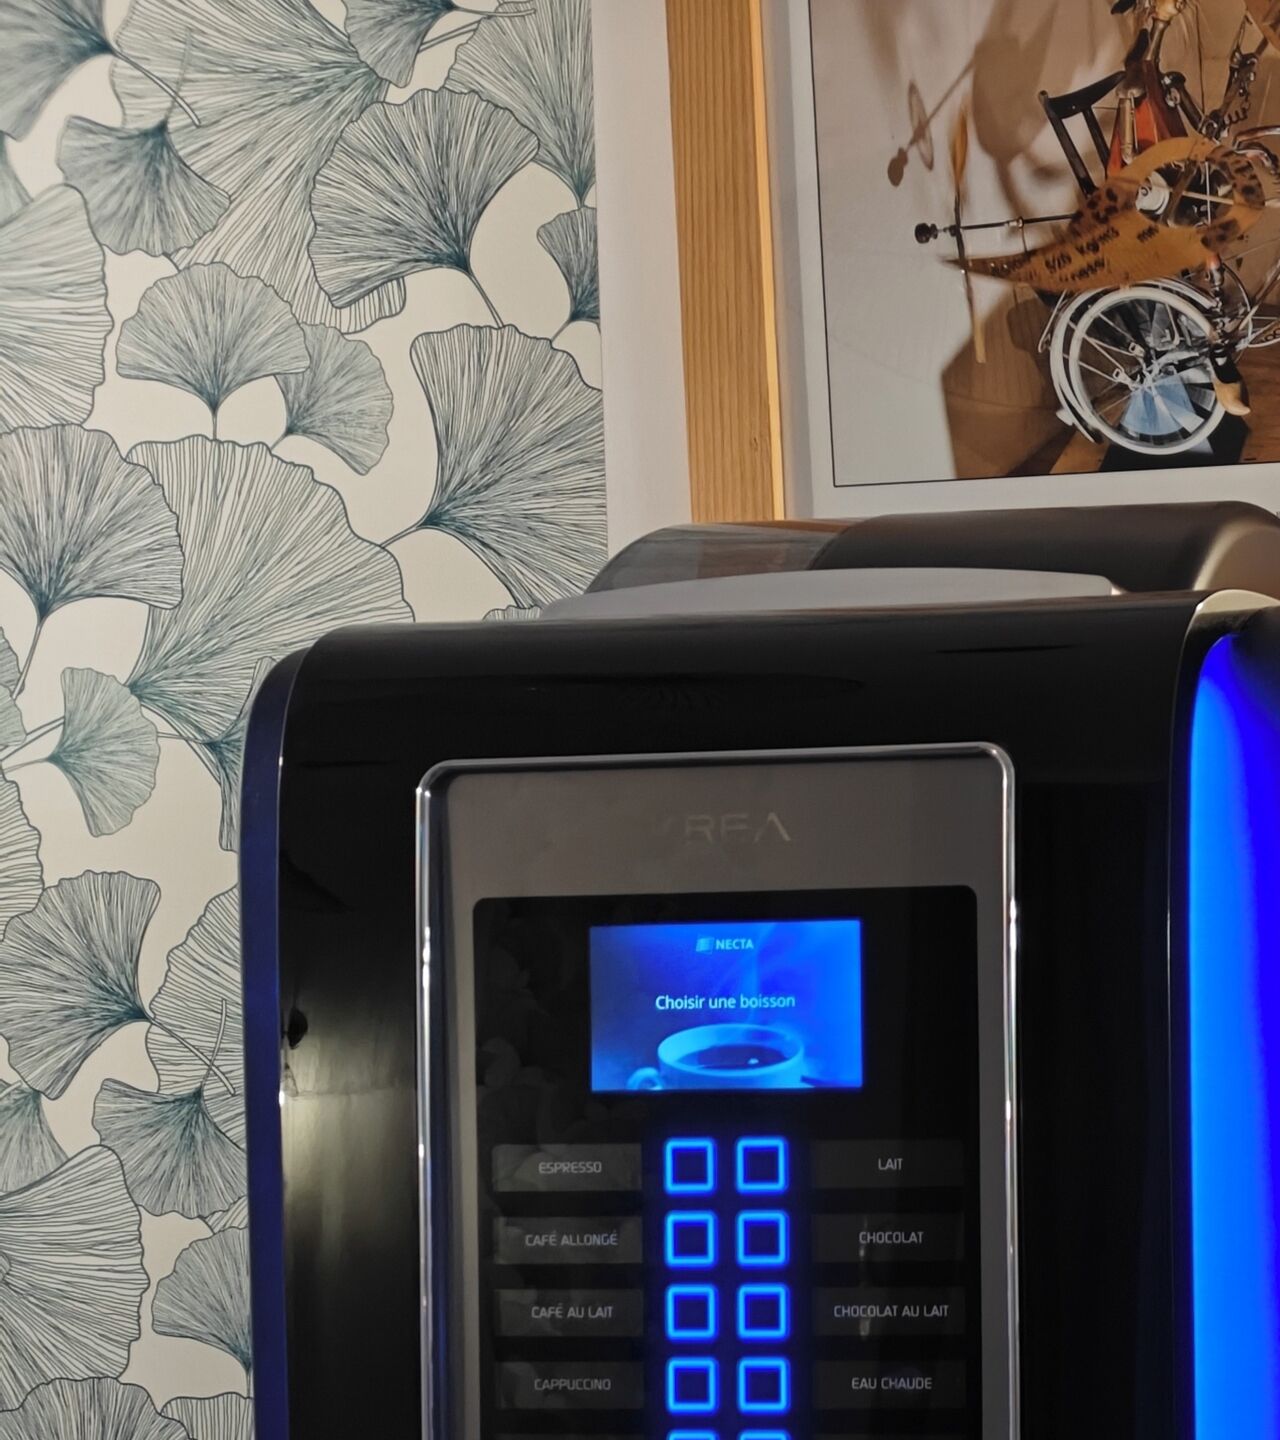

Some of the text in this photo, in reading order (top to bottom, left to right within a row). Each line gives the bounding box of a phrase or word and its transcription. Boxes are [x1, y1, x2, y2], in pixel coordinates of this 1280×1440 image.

[657, 811, 792, 843] REA
[715, 938, 754, 951] NECTA
[655, 993, 796, 1010] Choisir une boisson
[538, 1161, 603, 1175] ESPRESSO
[877, 1157, 904, 1171] LAIT
[524, 1229, 619, 1247] CAFÉ ALLONGÉ
[858, 1231, 925, 1244] CHOCOLAT
[530, 1302, 615, 1319] CAFÉ AU LAIT
[833, 1304, 949, 1318] CHOCOLAT AU LAIT
[534, 1377, 612, 1391] CAPPUCCINO
[851, 1376, 933, 1390] EAU CHAUDE
